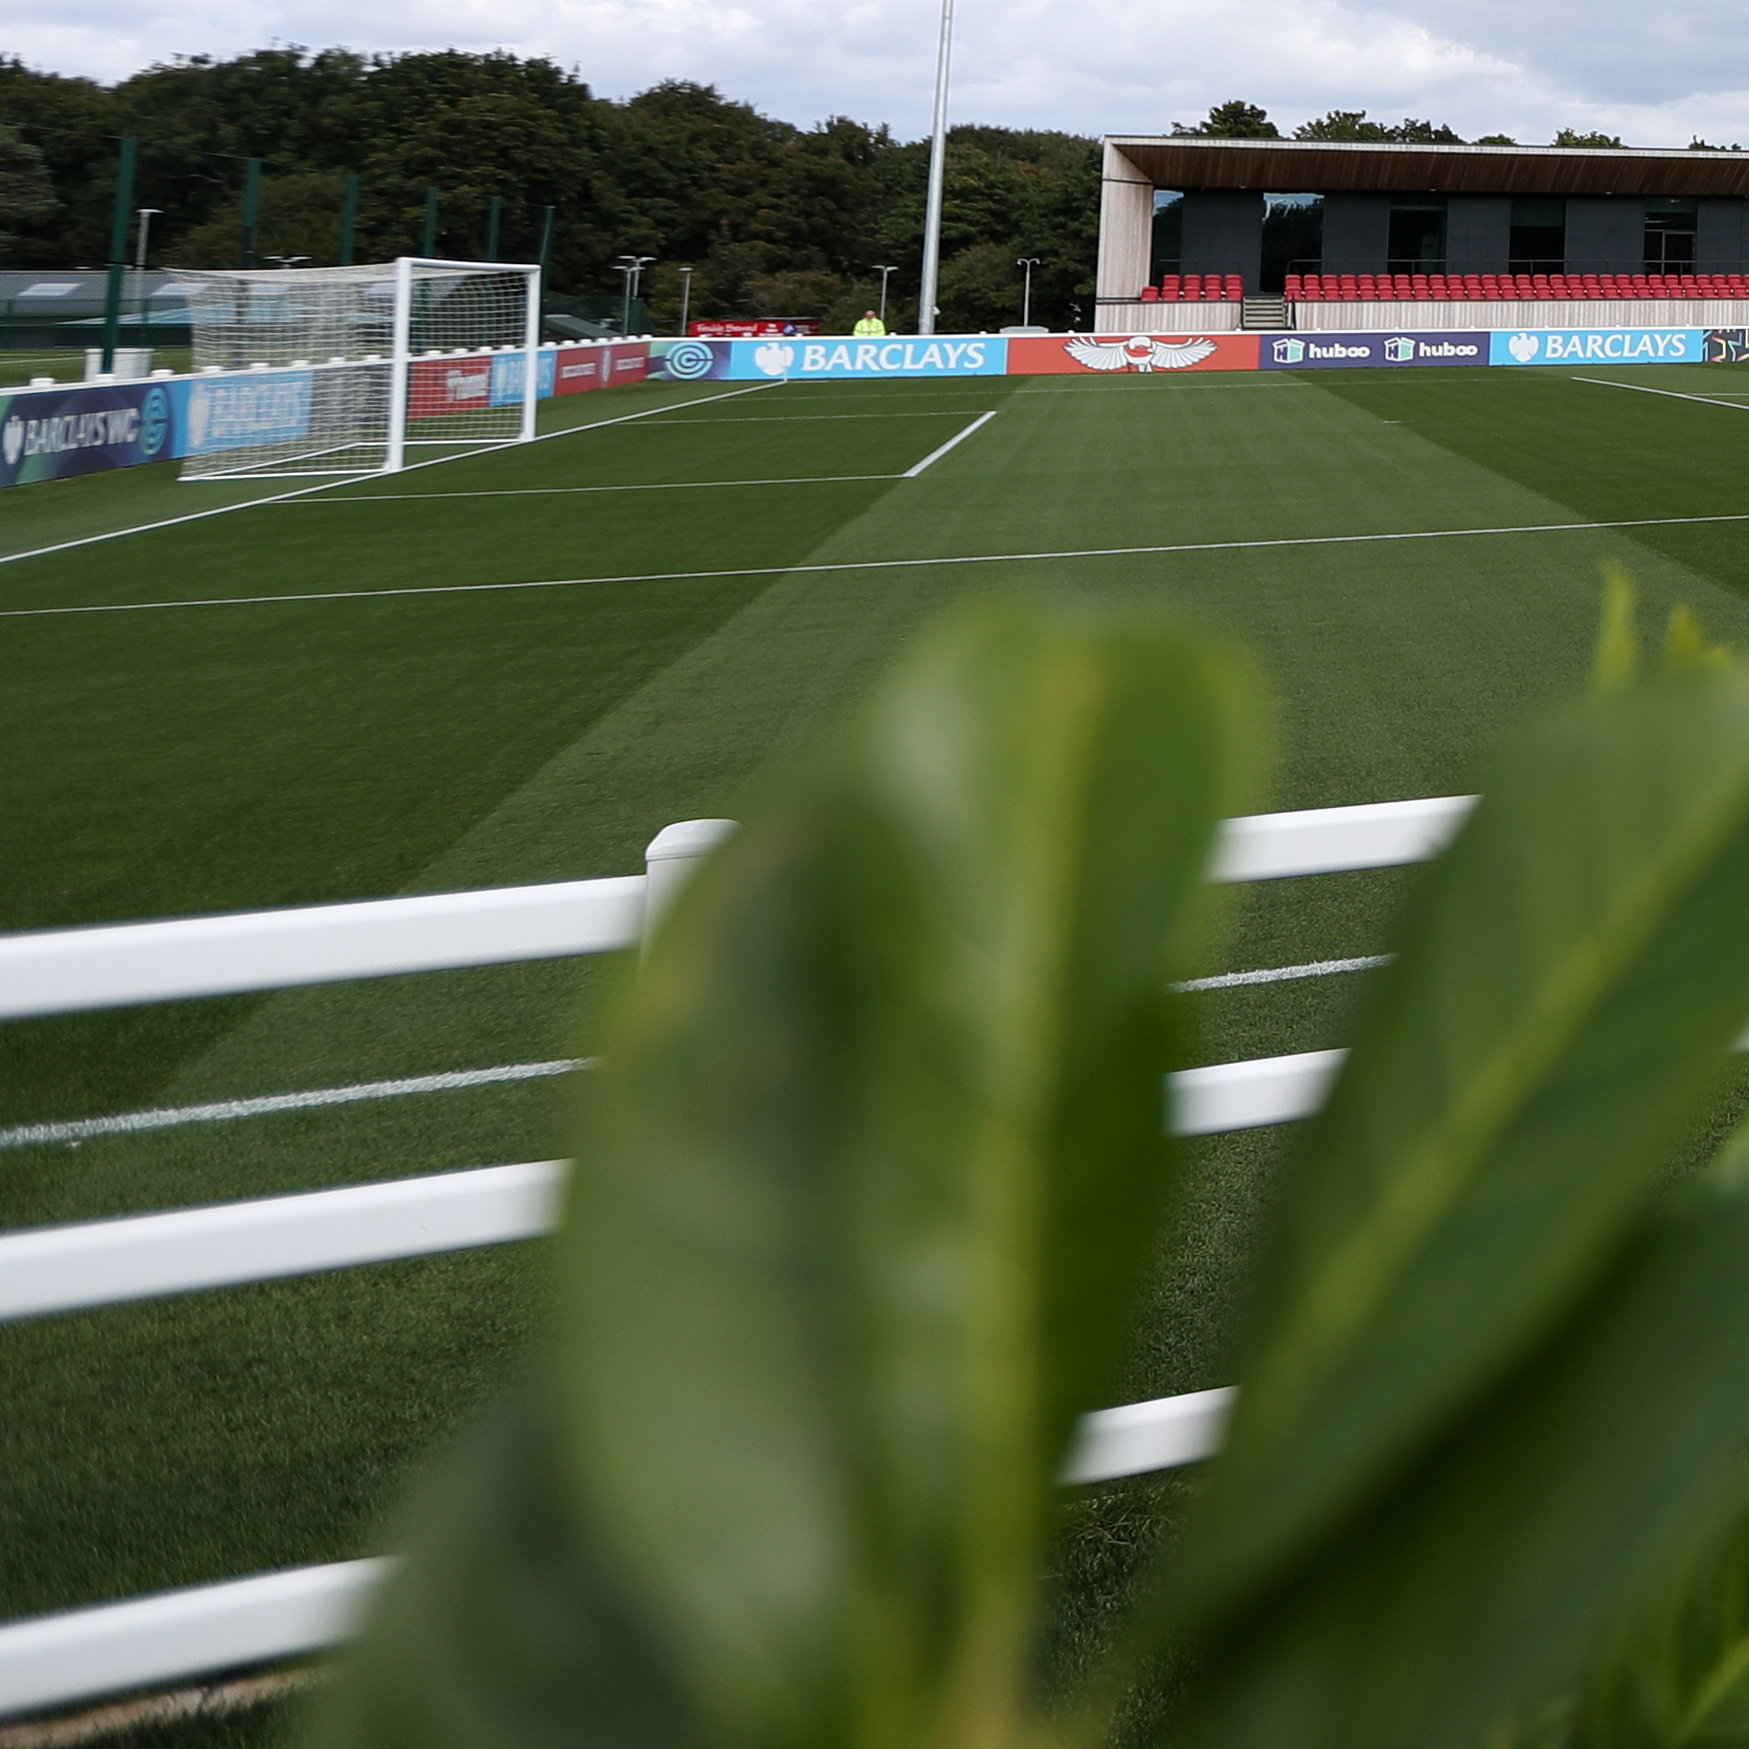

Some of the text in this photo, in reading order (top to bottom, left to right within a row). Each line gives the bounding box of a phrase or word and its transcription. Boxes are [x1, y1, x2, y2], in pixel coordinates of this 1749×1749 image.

[1308, 343, 1371, 358] huboo
[1419, 342, 1478, 357] huboo
[1545, 333, 1687, 359] BARCLAYS
[801, 342, 985, 371] BARCLAYS
